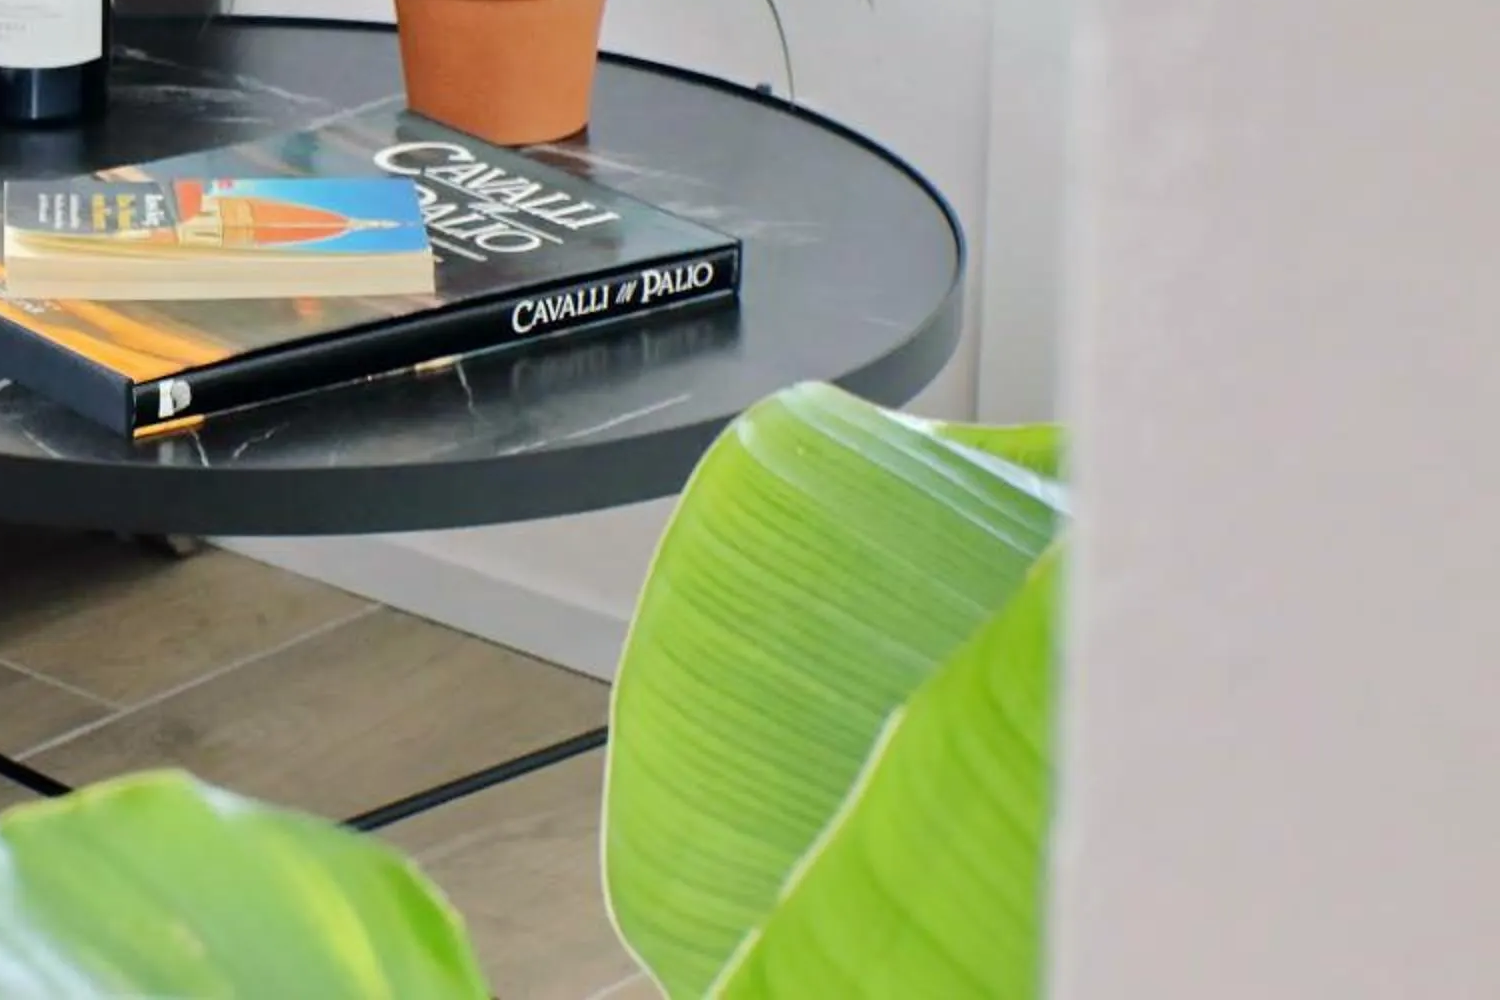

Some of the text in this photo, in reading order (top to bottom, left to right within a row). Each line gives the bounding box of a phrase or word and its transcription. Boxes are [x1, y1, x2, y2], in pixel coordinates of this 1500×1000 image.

[373, 141, 621, 230] CAVALLI
[512, 285, 609, 333] CAVALLI
[641, 262, 713, 303] PALIO
